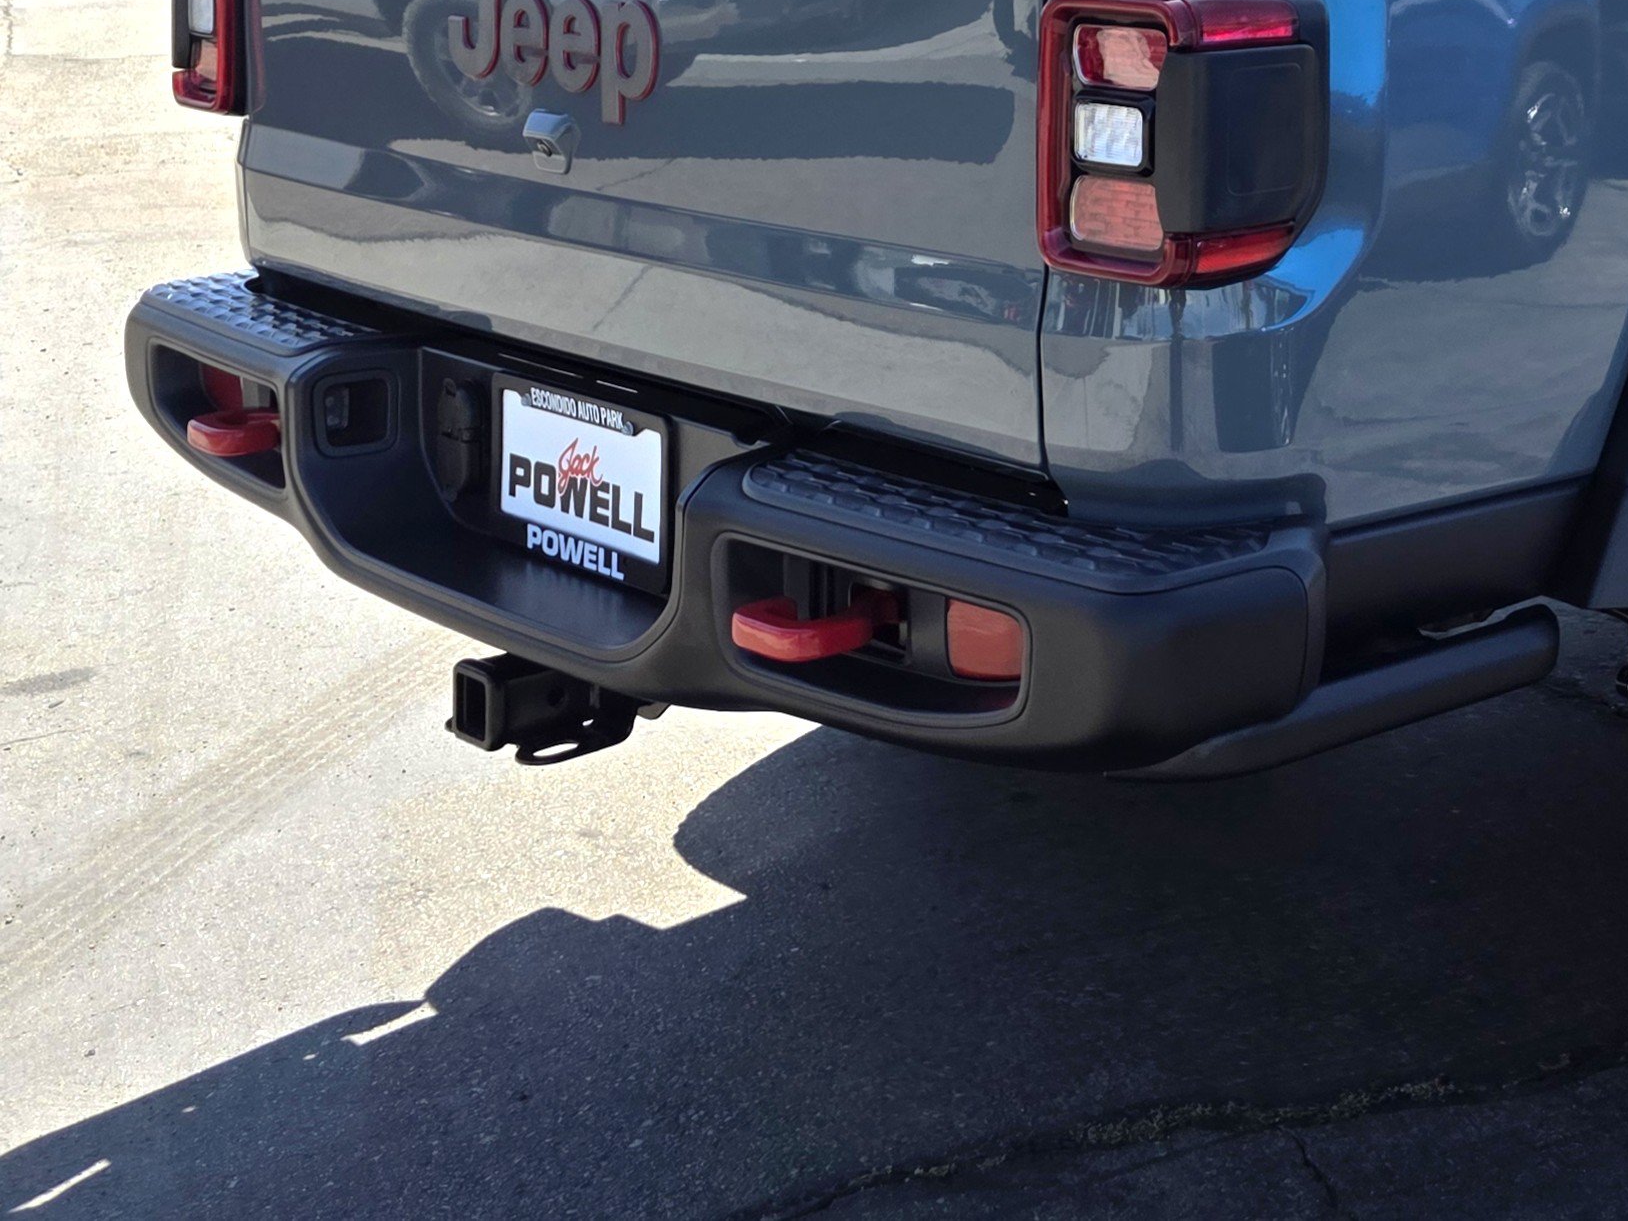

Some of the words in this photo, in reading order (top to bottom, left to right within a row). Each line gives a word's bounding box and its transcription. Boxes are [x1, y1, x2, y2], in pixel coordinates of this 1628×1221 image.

[530, 387, 577, 418] ESCONDIDO
[577, 400, 600, 424] AUTO
[600, 407, 624, 430] PARK
[558, 438, 603, 495] Jack
[509, 453, 655, 544] POWELL
[526, 524, 625, 581] POWELL
